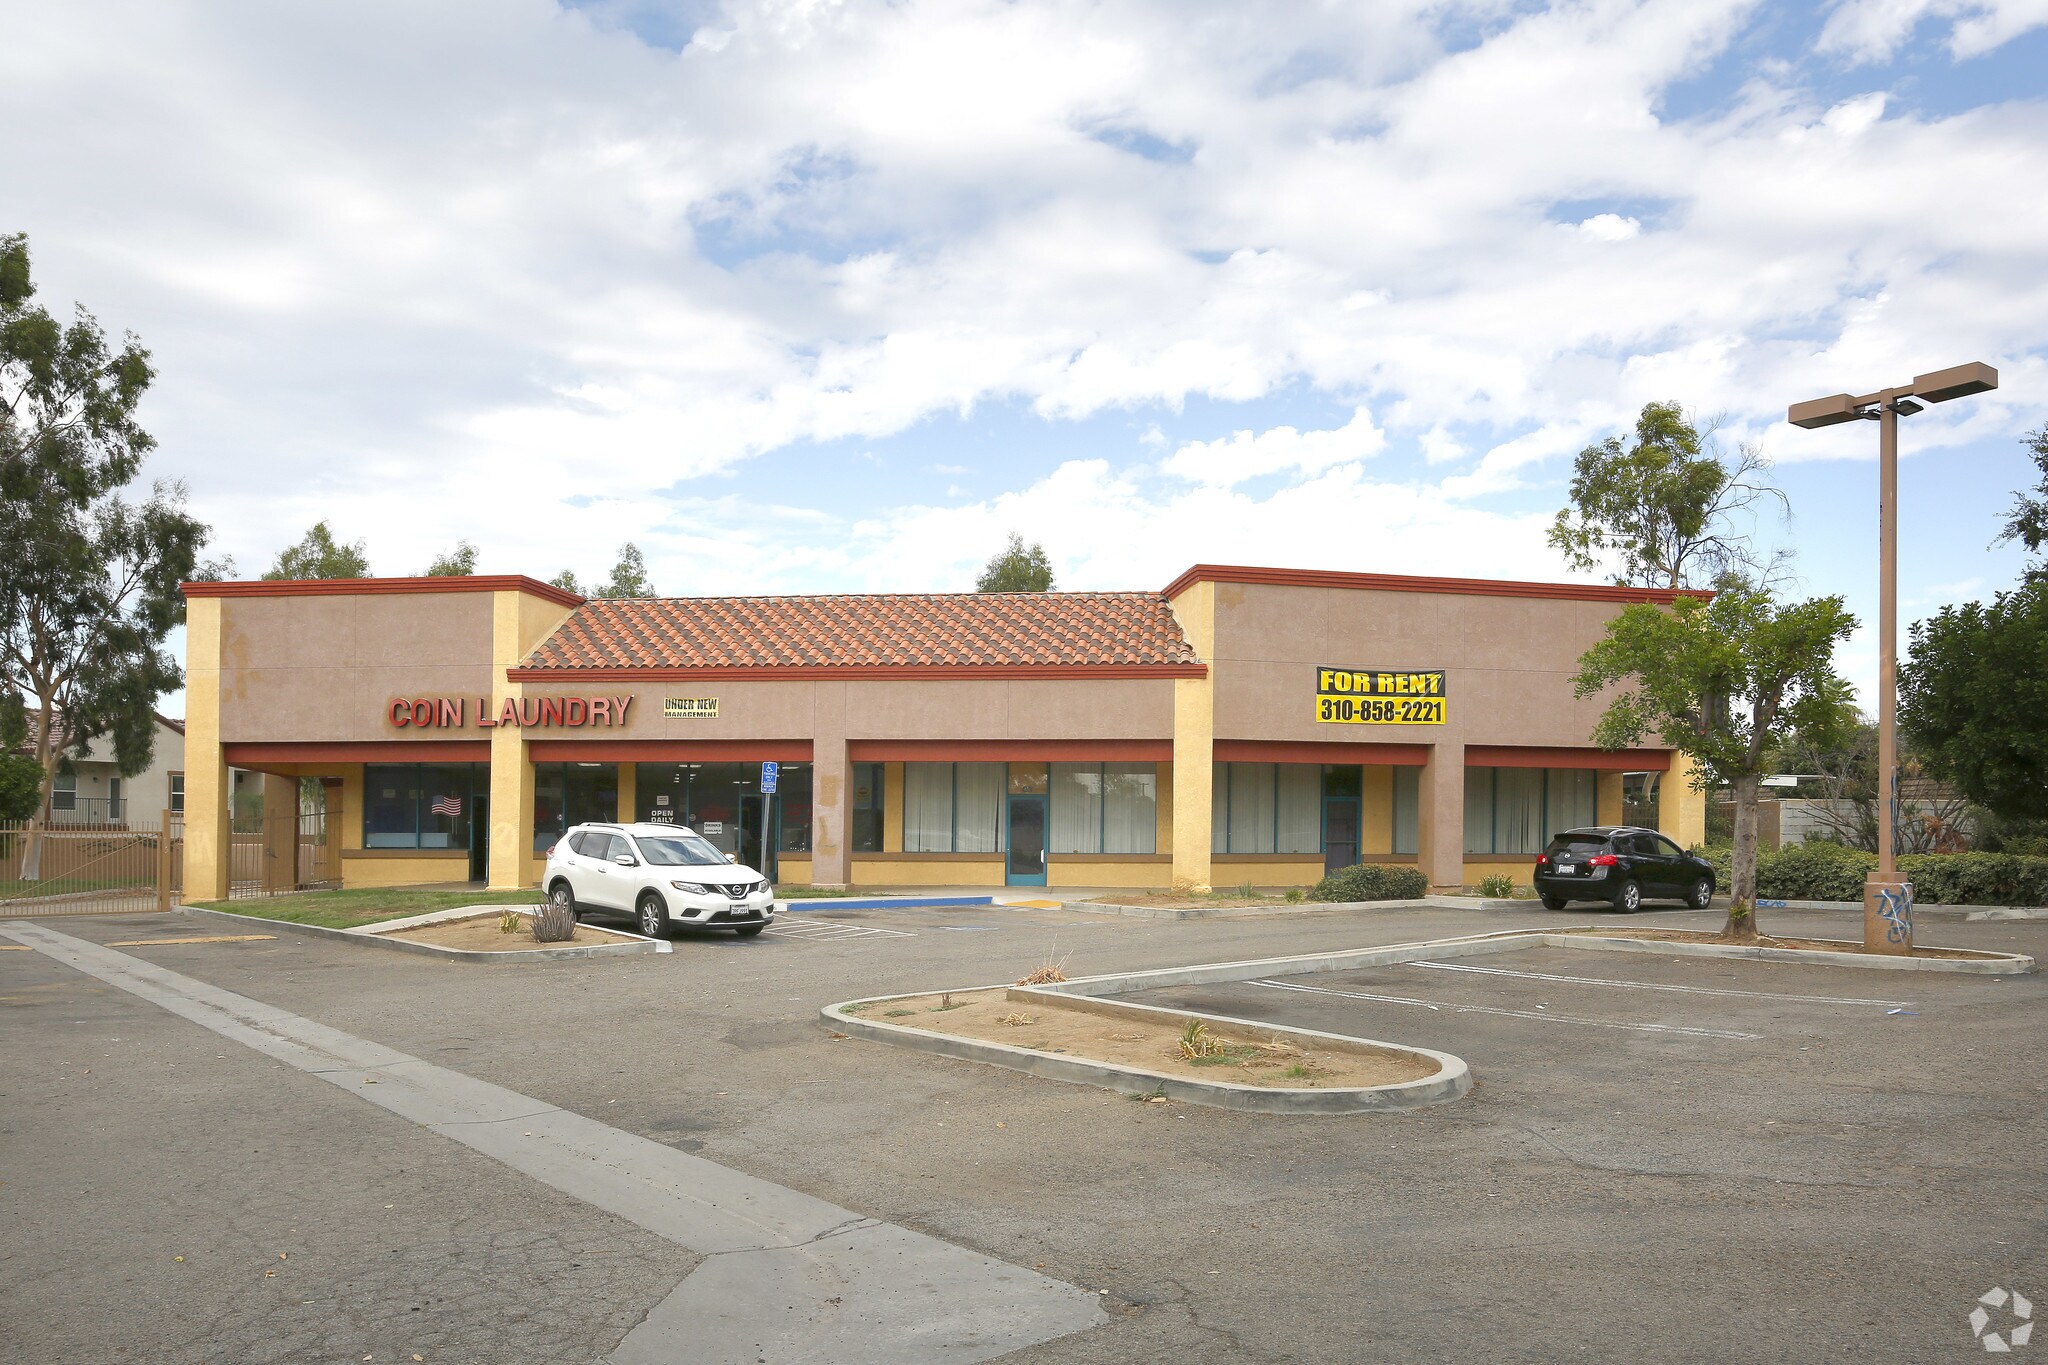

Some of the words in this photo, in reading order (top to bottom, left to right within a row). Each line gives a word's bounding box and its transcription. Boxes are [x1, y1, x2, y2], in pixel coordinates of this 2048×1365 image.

[1320, 670, 1371, 693] FOR
[1377, 673, 1442, 694] RENT
[388, 697, 464, 727] COIN
[475, 695, 634, 727] LAUNDRY
[665, 698, 694, 710] UNDER
[697, 698, 718, 710] NEW
[1321, 698, 1442, 722] 310-858-2221
